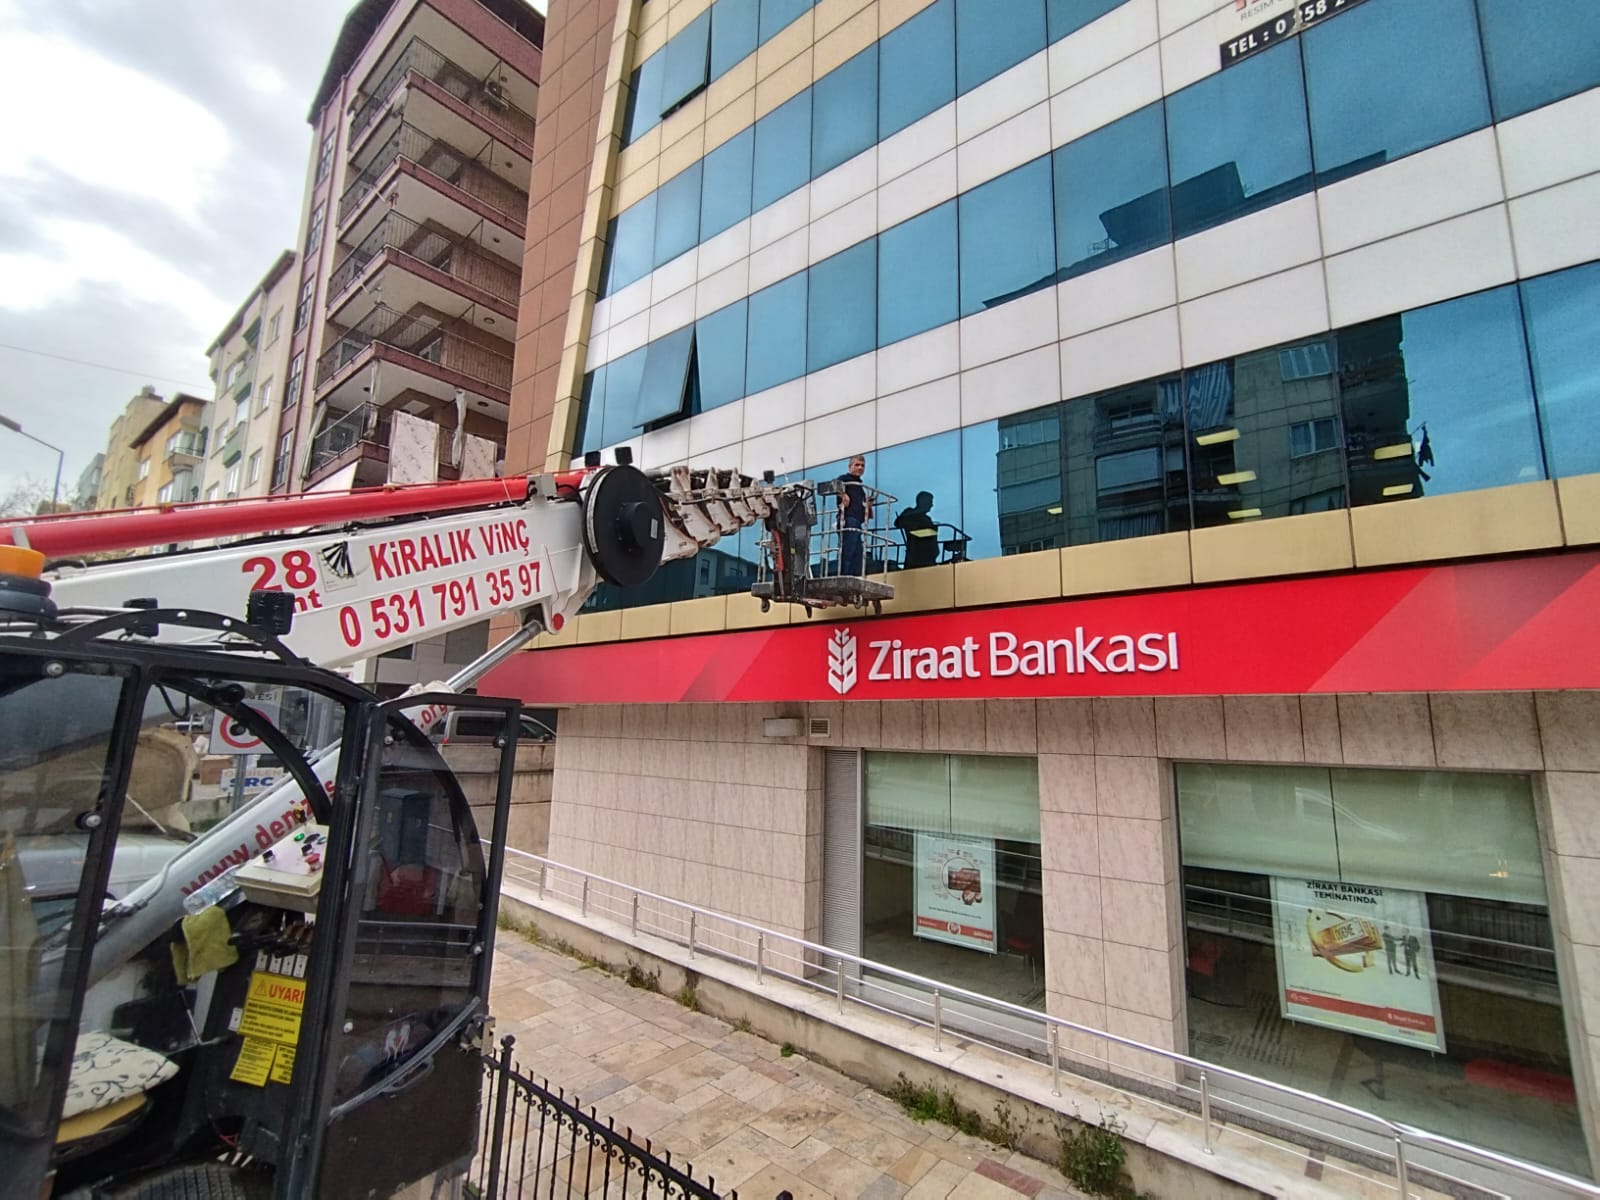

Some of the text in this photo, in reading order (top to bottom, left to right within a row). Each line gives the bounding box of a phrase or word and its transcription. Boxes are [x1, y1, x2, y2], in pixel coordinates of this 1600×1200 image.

[1228, 34, 1258, 57] TEL
[1275, 19, 1287, 34] 0
[242, 550, 317, 592] 28
[339, 561, 541, 648] 0 531 791 35 97
[868, 626, 1179, 681] Ziraat Bankası
[181, 798, 315, 895] www.denz
[268, 984, 304, 1004] UYARI
